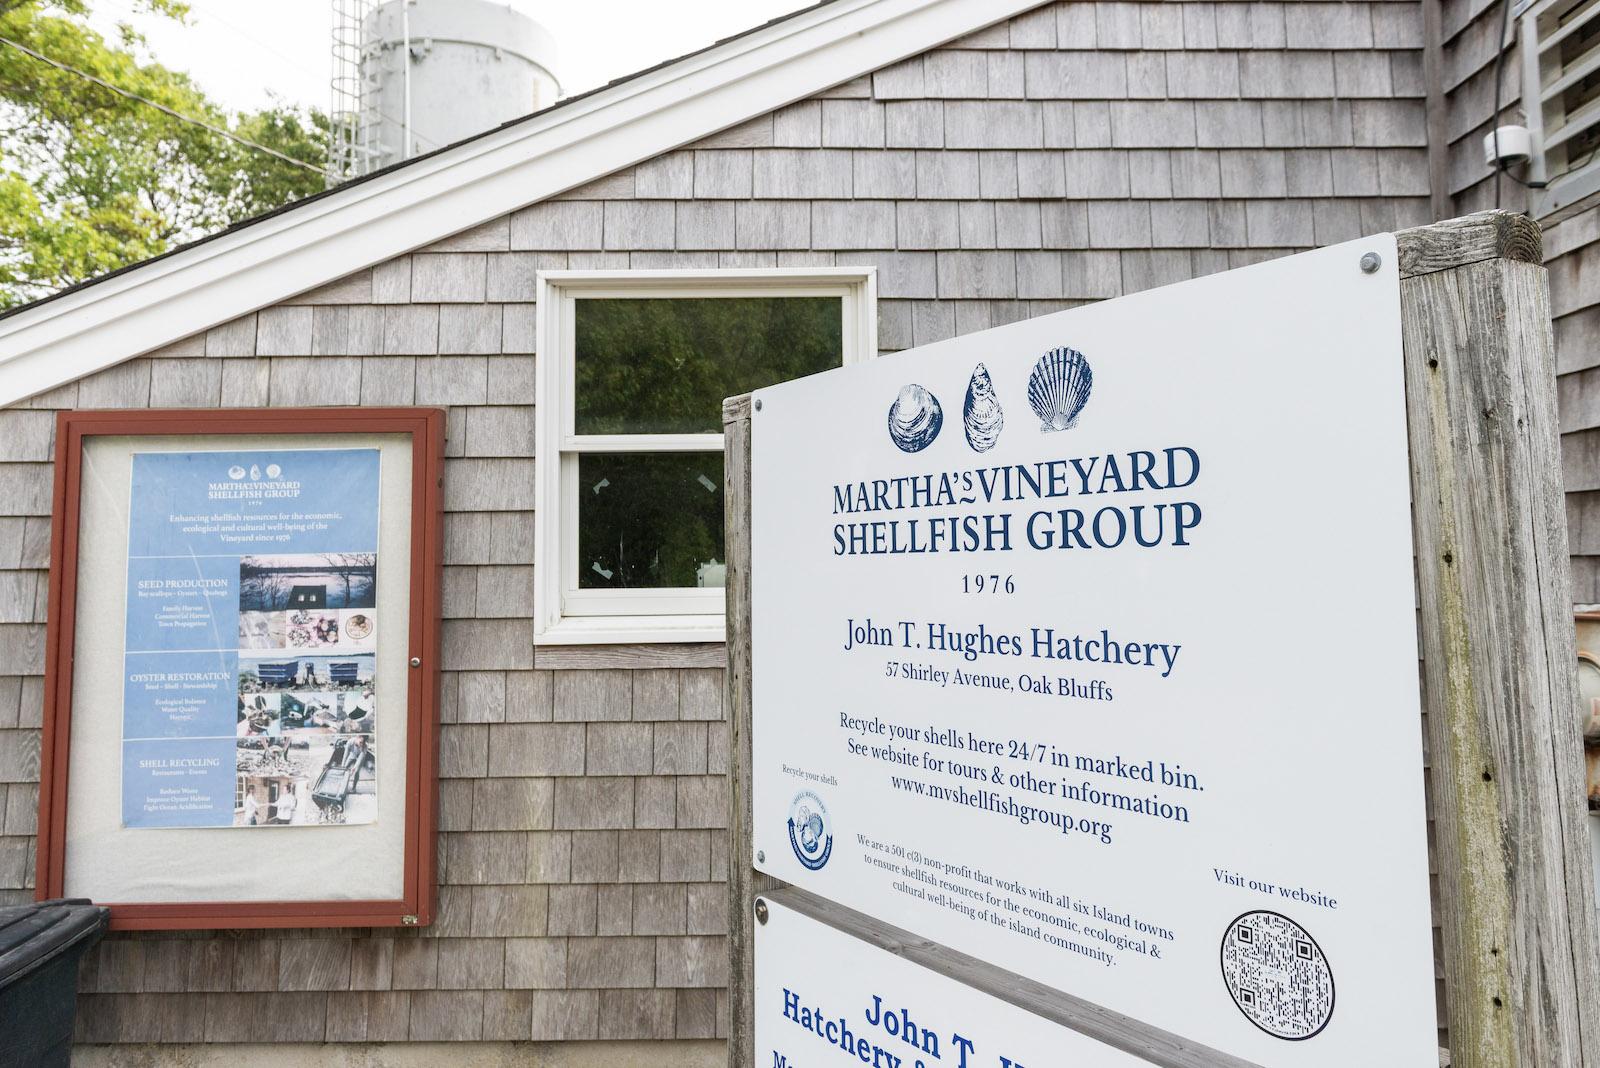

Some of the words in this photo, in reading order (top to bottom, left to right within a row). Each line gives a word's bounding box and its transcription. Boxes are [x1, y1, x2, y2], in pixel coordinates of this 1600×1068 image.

[208, 490, 262, 499] SHELLFISH
[264, 489, 301, 498] GROUP
[253, 481, 300, 490] VINEYARD
[832, 471, 976, 514] MARTHA'S
[975, 446, 1201, 503] VINEYARD
[169, 514, 209, 523] Enhancing
[210, 512, 242, 522] shellfish
[243, 513, 278, 521] resources
[279, 511, 290, 520] for
[291, 511, 304, 520] the
[304, 511, 342, 520] economic,
[183, 524, 220, 534] ecological
[221, 523, 236, 532] and
[236, 523, 266, 532] cultural
[267, 522, 306, 533] well-being
[307, 521, 315, 531] of
[315, 521, 328, 530] the
[834, 513, 1013, 556] SHELLFISH
[1026, 501, 1202, 551] GROUP
[220, 534, 254, 544] Vineyard
[255, 533, 274, 542] since
[275, 534, 291, 542] 1976
[138, 580, 164, 589] SEED
[165, 579, 228, 588] PRODUCTION
[962, 574, 1015, 594] 1976
[844, 618, 894, 651] John
[898, 621, 920, 649] T.
[927, 623, 1022, 662] Hughes
[1030, 628, 1182, 678] Hatchery
[130, 674, 166, 682] OYSTER
[168, 672, 231, 681] RESTORATION
[885, 661, 899, 677] 57
[902, 663, 949, 688] Shirley
[953, 668, 1014, 693] Avenue,
[1018, 674, 1053, 695] Oak
[1057, 678, 1113, 701] Bluffs
[139, 760, 168, 769] SHELL
[169, 758, 220, 768] RECYCLING
[840, 712, 886, 736] Recycle
[889, 725, 921, 741] your
[924, 726, 964, 749] shells
[968, 732, 1004, 756] here
[1008, 740, 1046, 763] 24/7
[1051, 745, 1070, 768] in
[1075, 756, 1154, 783] marked
[1160, 763, 1204, 791] bin.
[783, 764, 804, 776] Recycle
[805, 772, 819, 781] your
[821, 774, 837, 786] shells
[848, 737, 868, 757] See
[871, 745, 919, 767] website
[923, 751, 944, 772] for
[948, 760, 987, 782] tours
[991, 766, 1005, 785] &
[1009, 771, 1057, 795] other
[1061, 777, 1189, 823] information
[891, 776, 1113, 844] www.mvshellfishgroup.org
[857, 834, 870, 846] We
[871, 841, 883, 851] are
[885, 845, 889, 853] a
[891, 845, 905, 858] 501
[907, 851, 922, 864] c(3)
[924, 858, 971, 879] non-profit
[974, 870, 993, 886] that
[995, 879, 1027, 896] works
[1029, 888, 1053, 904] with
[1056, 895, 1070, 909] all
[1073, 900, 1090, 915] six
[1093, 905, 1131, 928] Island
[1134, 920, 1174, 941] towns
[864, 854, 872, 864] to
[873, 859, 900, 873] ensure
[902, 865, 937, 886] shellfish
[939, 880, 984, 901] resources
[986, 892, 1001, 907] for
[1004, 898, 1020, 913] the
[1022, 907, 1081, 934] economic,
[1084, 927, 1146, 954] ecological
[1150, 944, 1161, 959] &
[1213, 868, 1245, 887] Visit
[1249, 880, 1275, 894] our
[1279, 887, 1337, 909] website
[893, 881, 925, 899] cultural
[927, 893, 975, 920] well-being
[977, 910, 989, 921] of
[990, 912, 1006, 927] the
[1009, 917, 1041, 940] island
[1043, 933, 1116, 967] community.
[865, 994, 941, 1060] John
